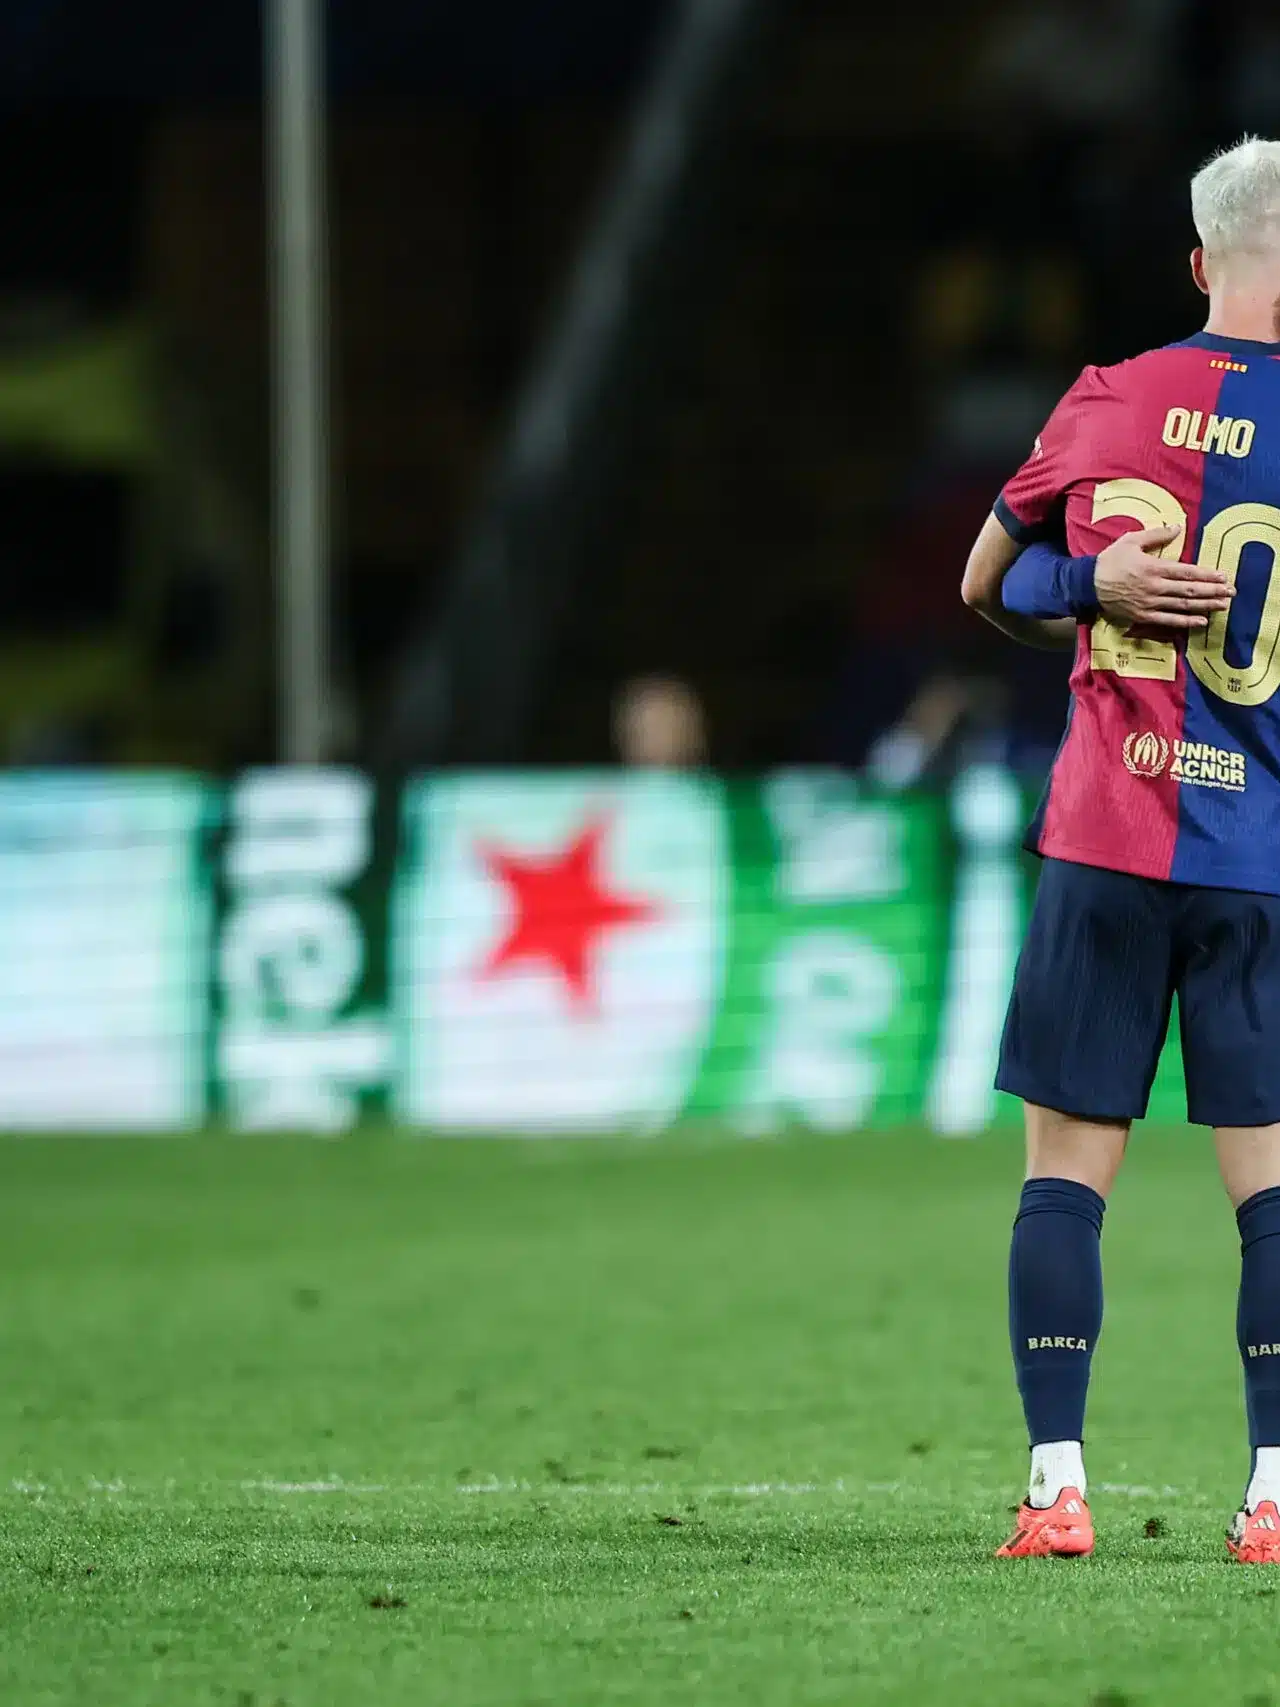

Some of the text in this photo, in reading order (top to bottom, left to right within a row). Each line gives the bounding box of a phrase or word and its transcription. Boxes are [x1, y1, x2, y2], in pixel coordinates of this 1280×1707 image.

[1162, 407, 1255, 458] OLMO
[1173, 739, 1245, 770] UNHCR
[1169, 757, 1246, 785] ACNUR
[1028, 1336, 1087, 1352] BARÇA
